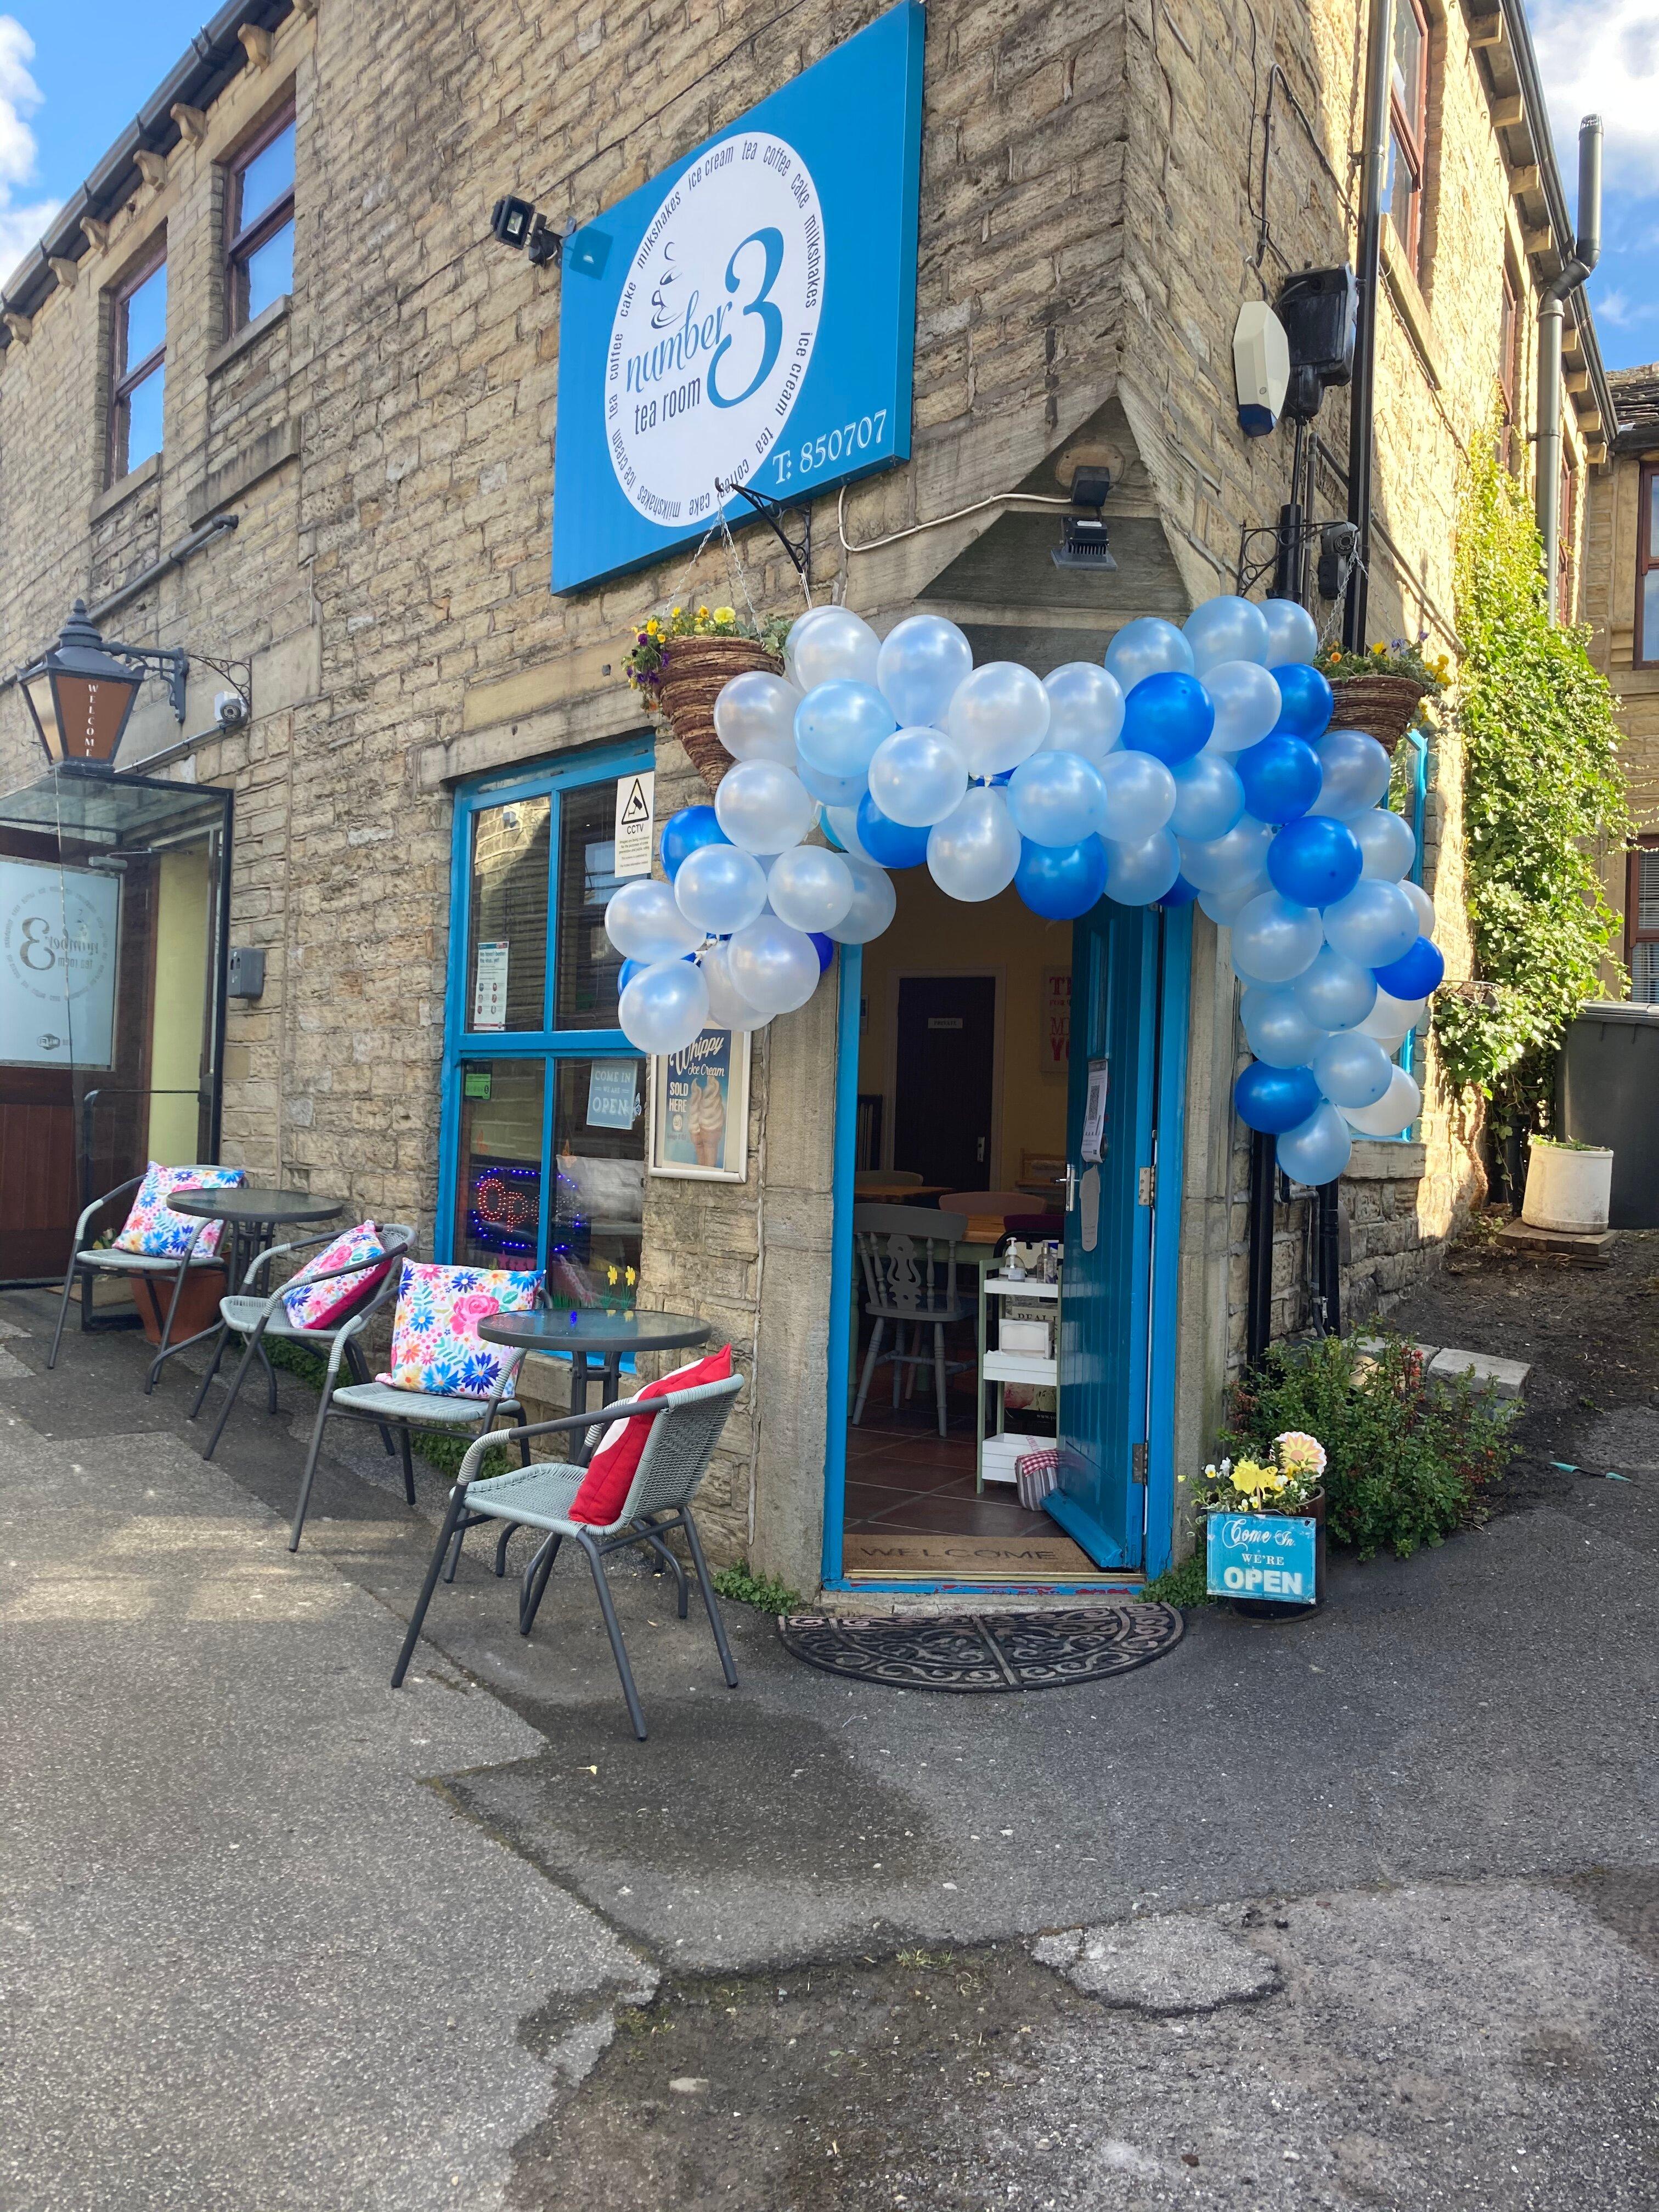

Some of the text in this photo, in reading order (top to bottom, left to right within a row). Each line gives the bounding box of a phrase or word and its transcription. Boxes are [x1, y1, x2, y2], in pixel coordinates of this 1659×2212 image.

[705, 145, 734, 176] cream
[743, 139, 758, 161] tea
[763, 145, 791, 176] coffee
[688, 166, 702, 191] ice
[791, 172, 810, 210] cake
[637, 191, 681, 269] milkshakes
[804, 213, 821, 309] milkshakes
[620, 281, 636, 318] cake
[627, 226, 785, 409] number 3
[610, 333, 624, 381] coffee
[795, 332, 813, 357] ice
[775, 363, 802, 416] cream
[608, 393, 618, 420] tea
[634, 377, 701, 435] tea room
[612, 428, 628, 471] cream
[755, 426, 774, 455] tea
[772, 409, 887, 484] T: 850707
[624, 466, 636, 492] ice
[637, 486, 681, 521] milkshakes
[689, 492, 710, 516] cake
[85, 684, 99, 757] WELCOME
[627, 823, 644, 834] CCTV
[669, 1036, 724, 1075] Whippy
[688, 1063, 724, 1077] Ice Cream
[595, 1070, 631, 1084] COME IN
[669, 1081, 689, 1097] SOLD
[592, 1096, 629, 1116] OPEN
[669, 1098, 687, 1113] HERE
[1222, 1518, 1272, 1551] Come
[860, 1547, 1059, 1560] WELCOME
[1242, 1553, 1285, 1566] WE'RE
[1224, 1566, 1302, 1595] OPEN
